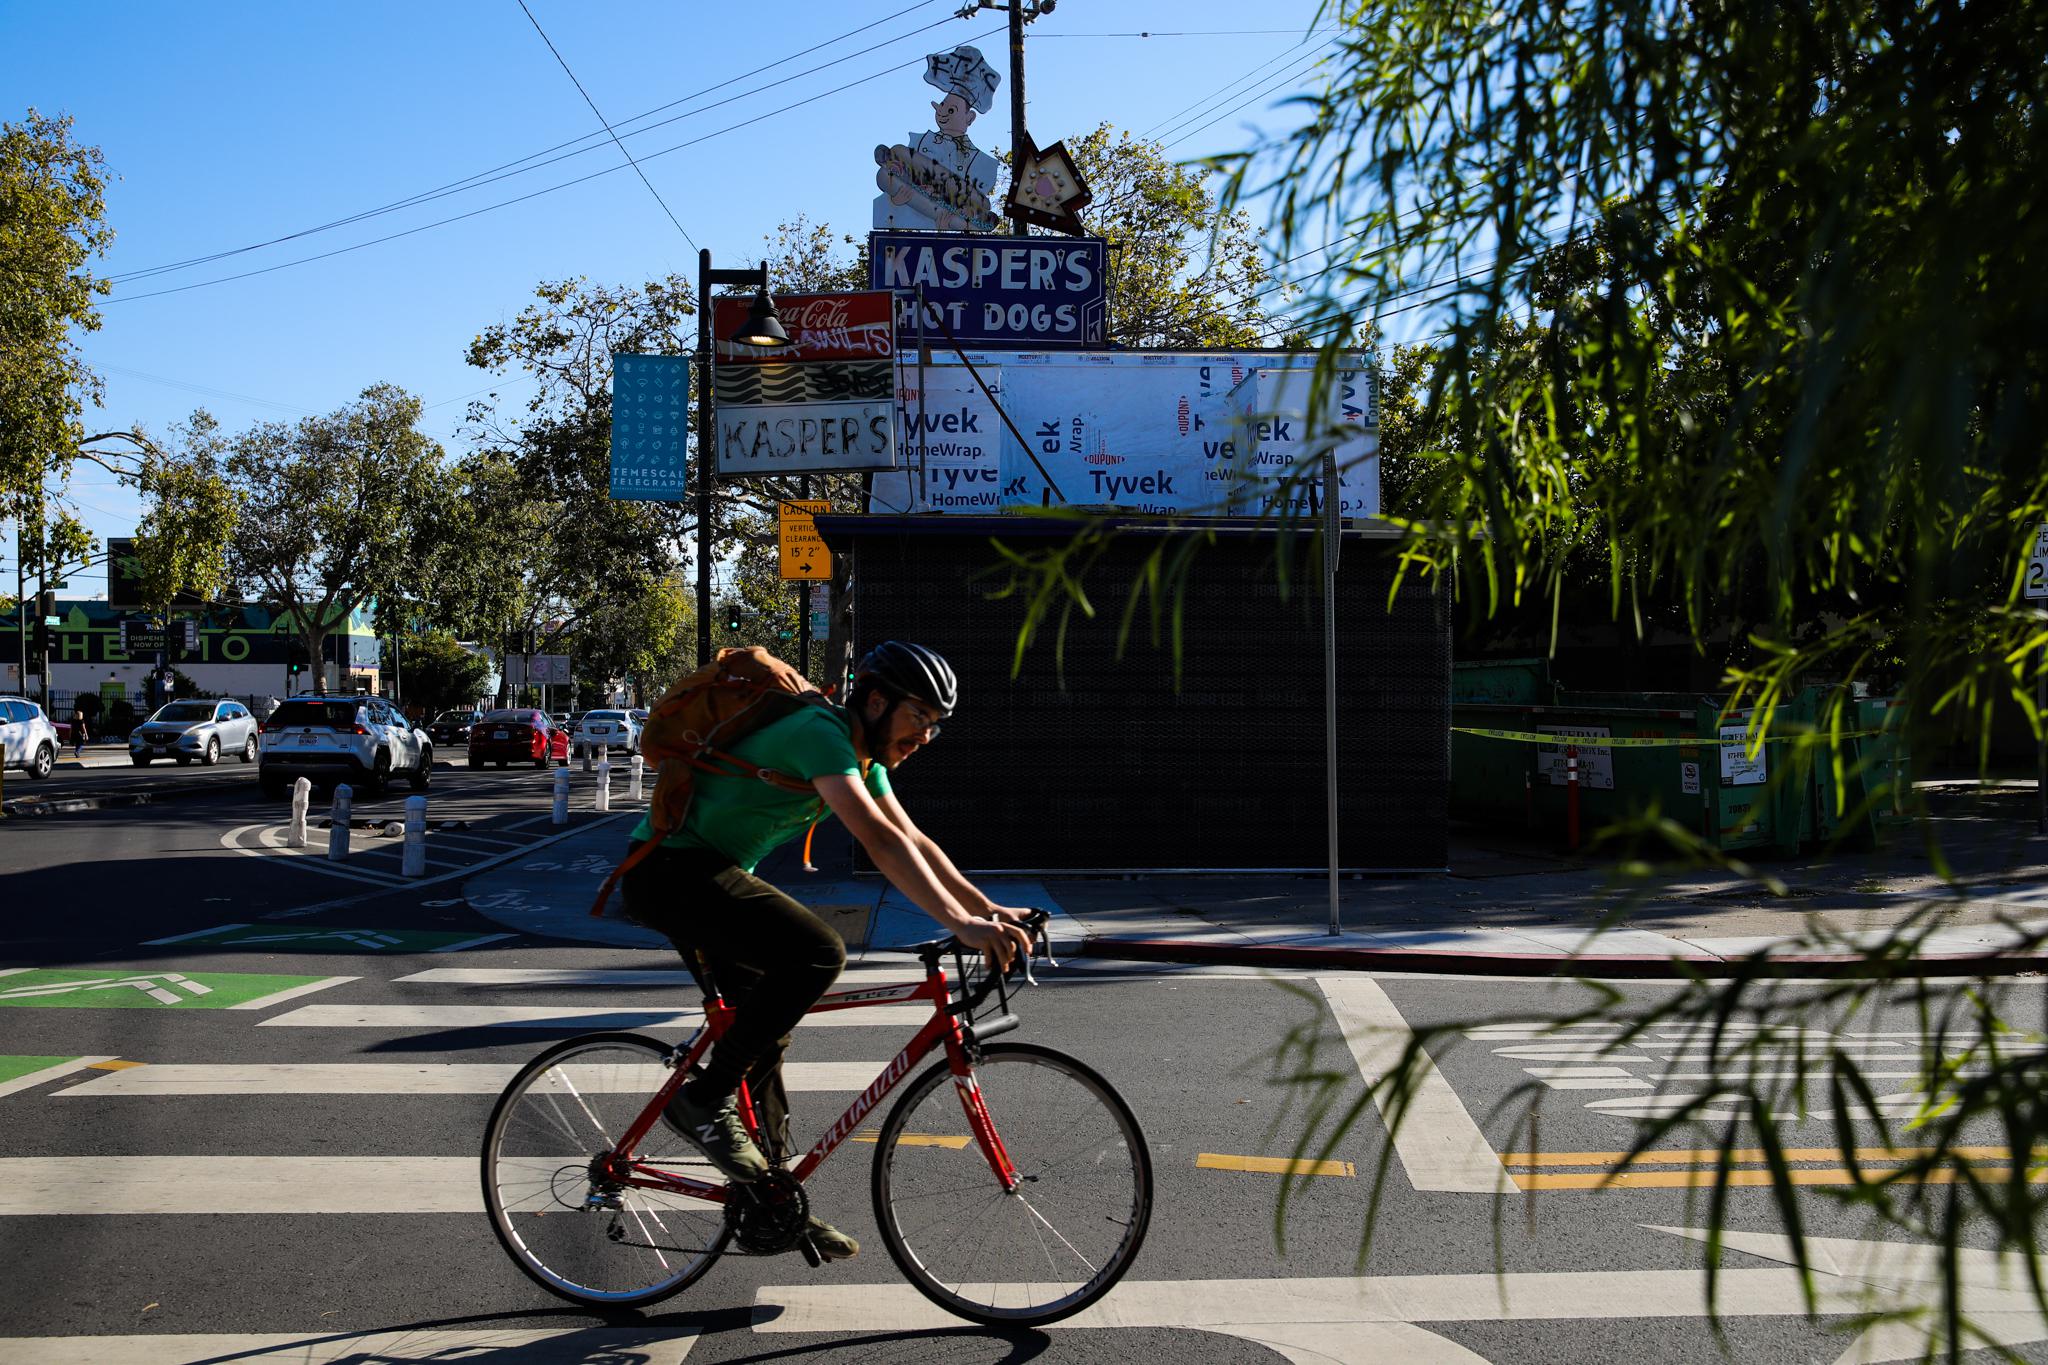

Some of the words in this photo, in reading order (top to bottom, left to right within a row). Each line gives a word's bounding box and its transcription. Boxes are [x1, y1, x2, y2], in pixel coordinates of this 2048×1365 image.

[884, 245, 1093, 292] KASPER'S
[900, 301, 968, 332] HOT
[984, 302, 1078, 333] DOGS
[1178, 399, 1190, 433] DUPONT
[724, 407, 888, 460] KASPER'S
[1089, 455, 1121, 464] DUPONT
[612, 467, 684, 479] TEMESCAL
[612, 477, 684, 488] TELEGRAPH
[1089, 470, 1173, 500] Tyvek
[783, 505, 827, 516] CAUTION
[785, 535, 823, 543] CLEARANC
[791, 546, 804, 557] 15'
[812, 1049, 910, 1159] SPECIALIZED
